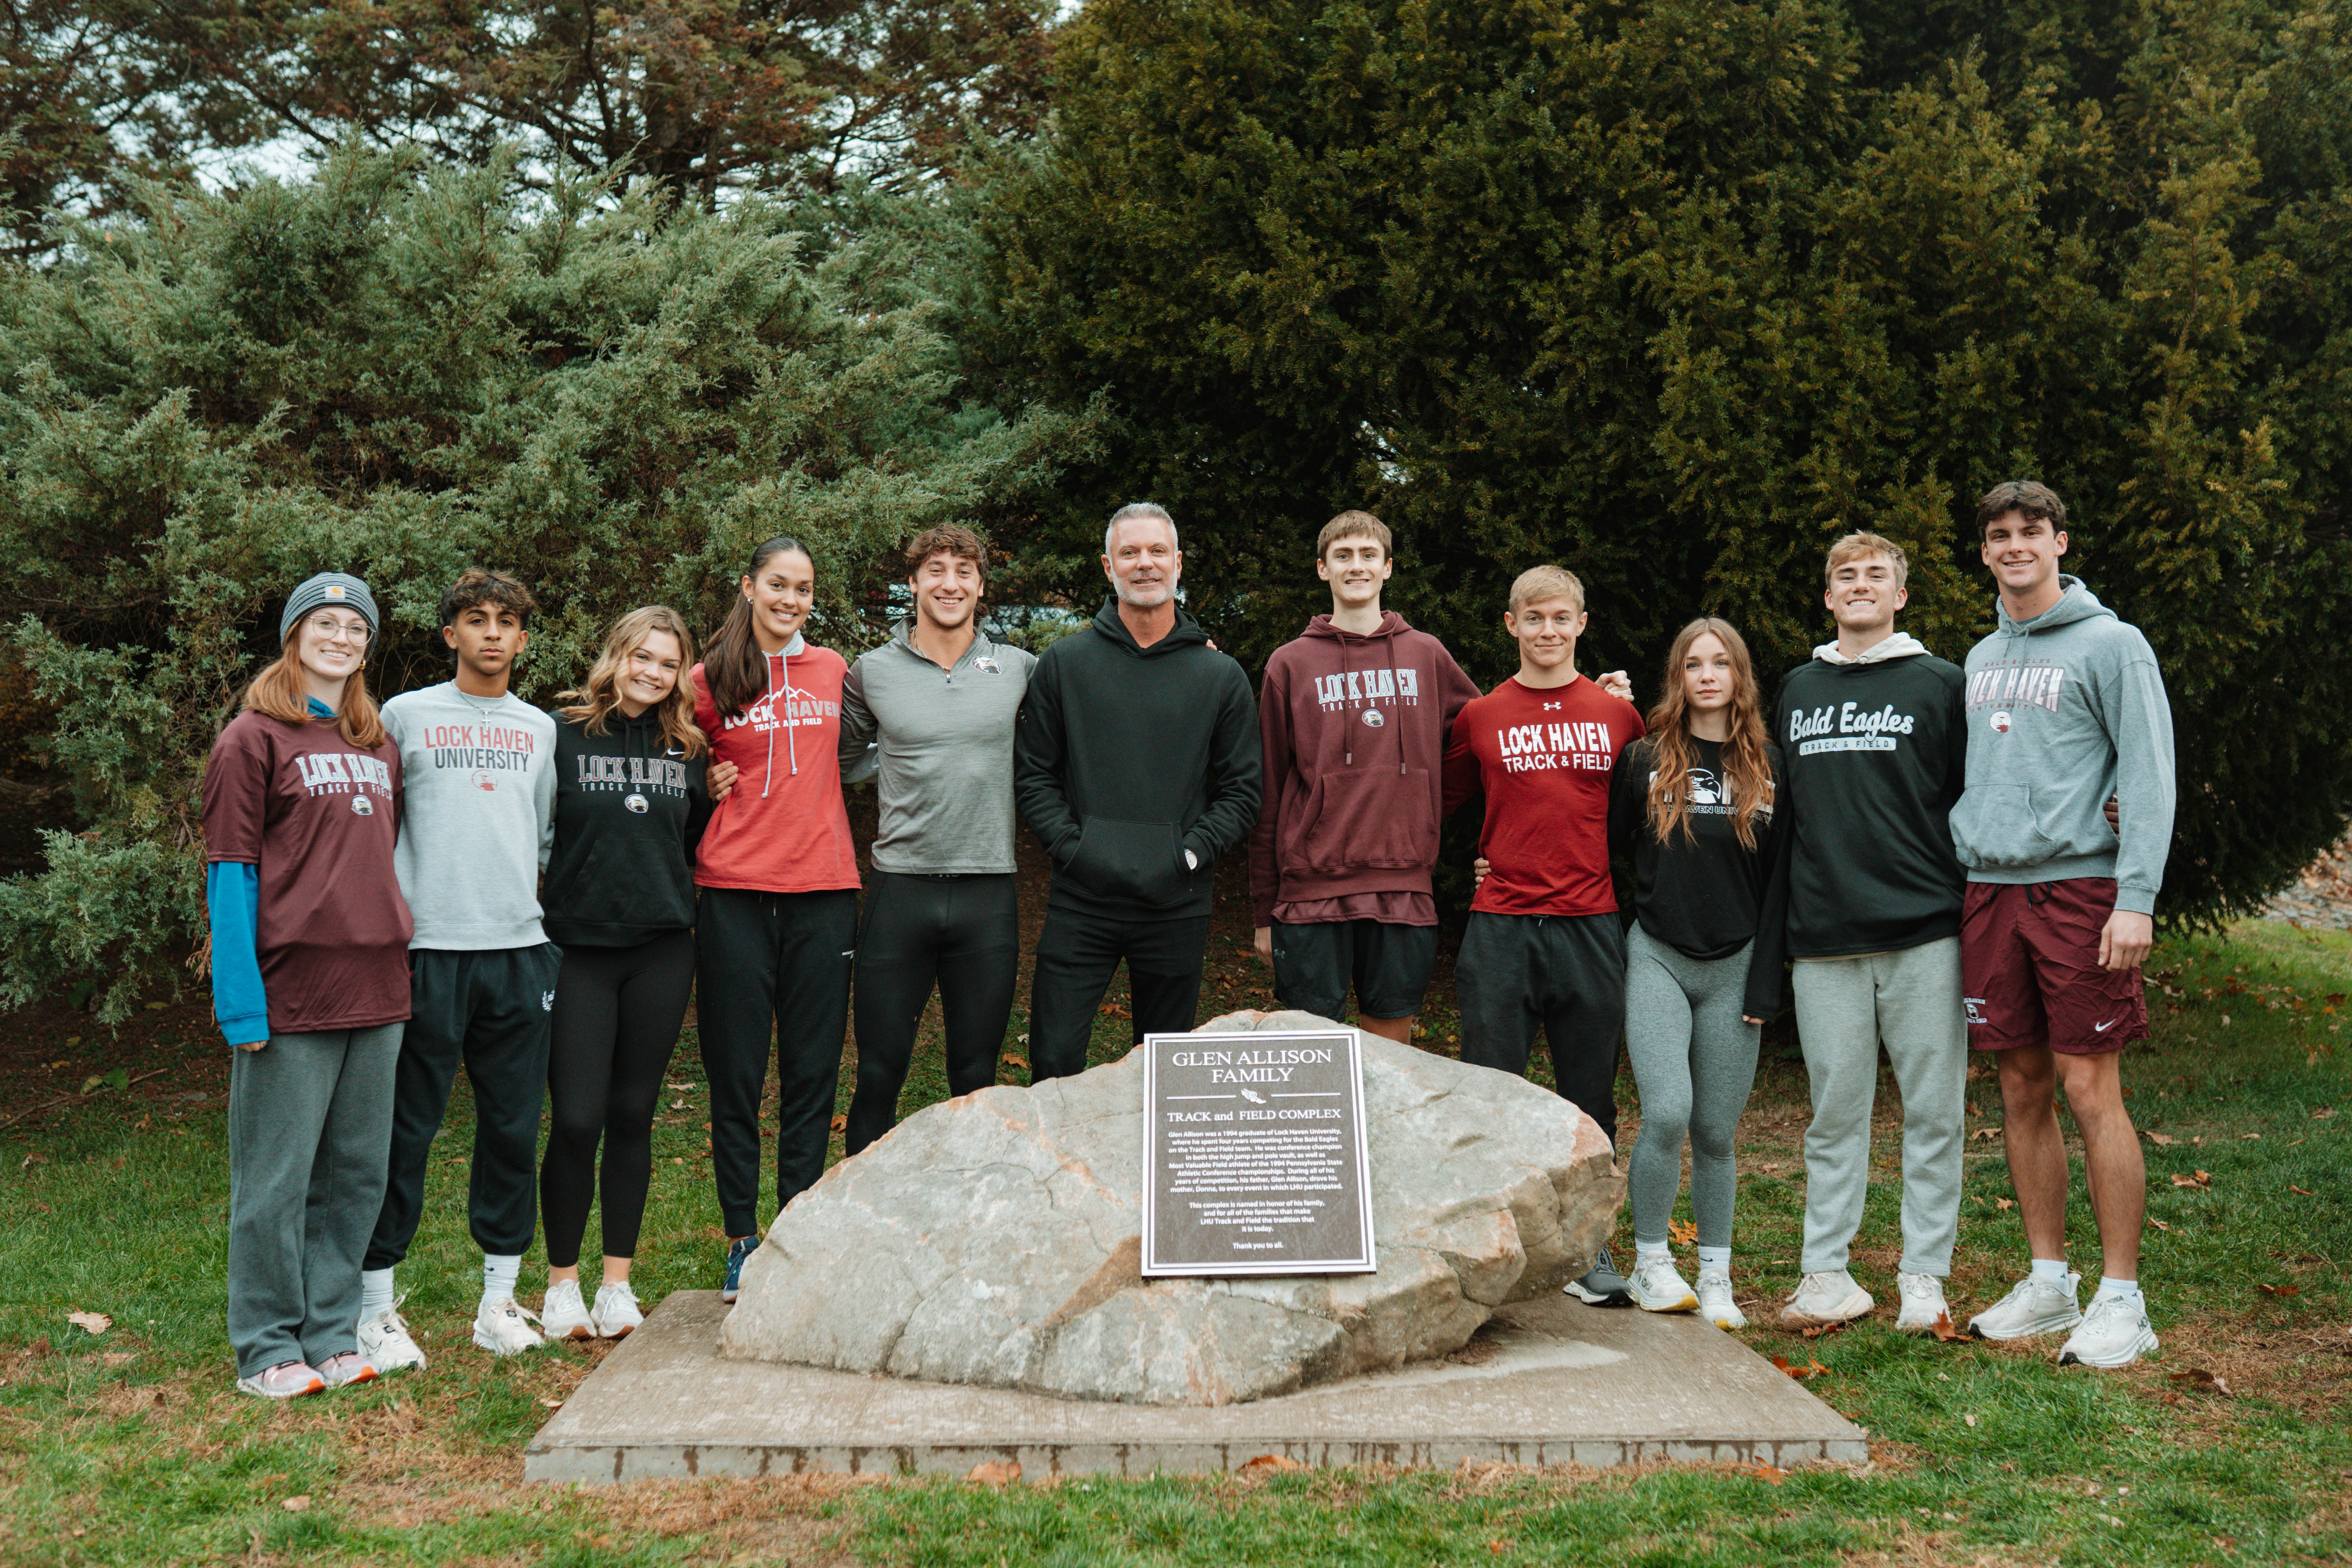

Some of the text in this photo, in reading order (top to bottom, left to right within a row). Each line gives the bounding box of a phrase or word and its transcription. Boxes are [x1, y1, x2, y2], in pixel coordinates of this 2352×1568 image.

[1315, 669, 1418, 704] LOCK HAVEN
[2002, 666, 2065, 713] HAVEN
[784, 701, 839, 718] HAVEN
[1322, 696, 1417, 713] TRAK & FILD
[1790, 701, 1914, 742] Bald Eagles
[424, 725, 534, 754] LOCK HAVEN
[1498, 722, 1611, 757] LOCK HAVEN
[1805, 741, 1837, 752] TRACK
[434, 748, 529, 772] UNIVERSITY
[1503, 753, 1611, 773] TRACK & FIELD
[295, 754, 392, 792] LOCK HAVEN
[577, 754, 686, 790] LOCK HAVEN
[309, 783, 350, 797] TRACK
[358, 783, 364, 793] &
[581, 783, 685, 799] TRACK & FIELD
[1681, 805, 1713, 813] AVEN
[1173, 1049, 1331, 1066] GLEN ALLISON
[1211, 1067, 1294, 1083] FAMILY
[1167, 1109, 1342, 1122] TRACK and FIELD COMPLEX
[1170, 1185, 1194, 1193] mother,
[1304, 1183, 1343, 1191] participated.
[1254, 1225, 1273, 1233] today.
